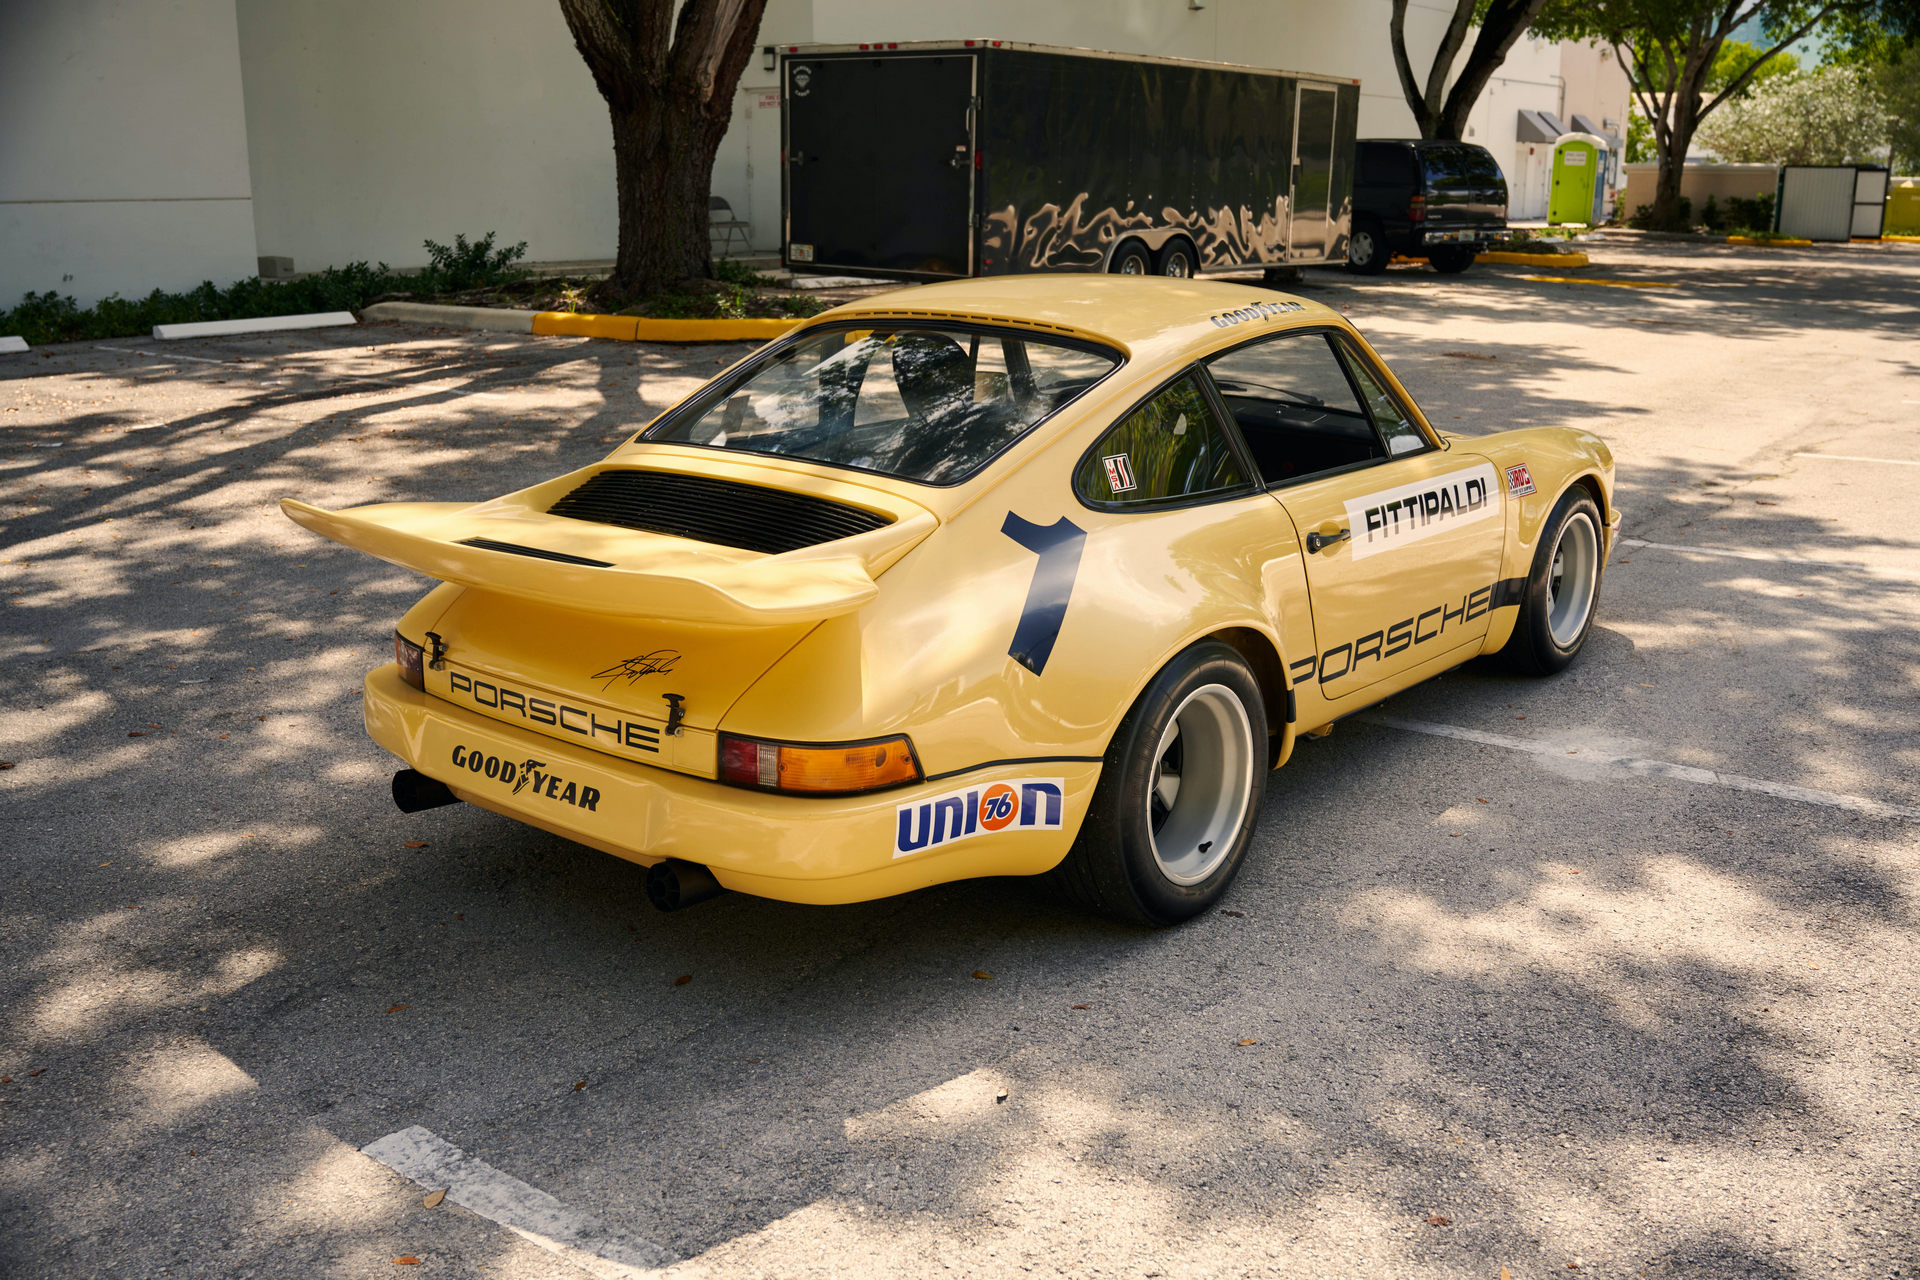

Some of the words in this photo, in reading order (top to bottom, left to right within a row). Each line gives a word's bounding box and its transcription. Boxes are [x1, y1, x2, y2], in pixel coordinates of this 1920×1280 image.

[1210, 301, 1306, 328] GOODYEAR
[1107, 460, 1120, 490] IMSA
[1512, 467, 1531, 489] IROC
[1365, 477, 1487, 543] FITTIPALDI
[1000, 510, 1088, 677] 1
[1290, 585, 1491, 685] PORSCHE
[450, 671, 660, 753] PORSCHE
[452, 745, 600, 812] GOODYEAR
[984, 791, 1012, 822] 76
